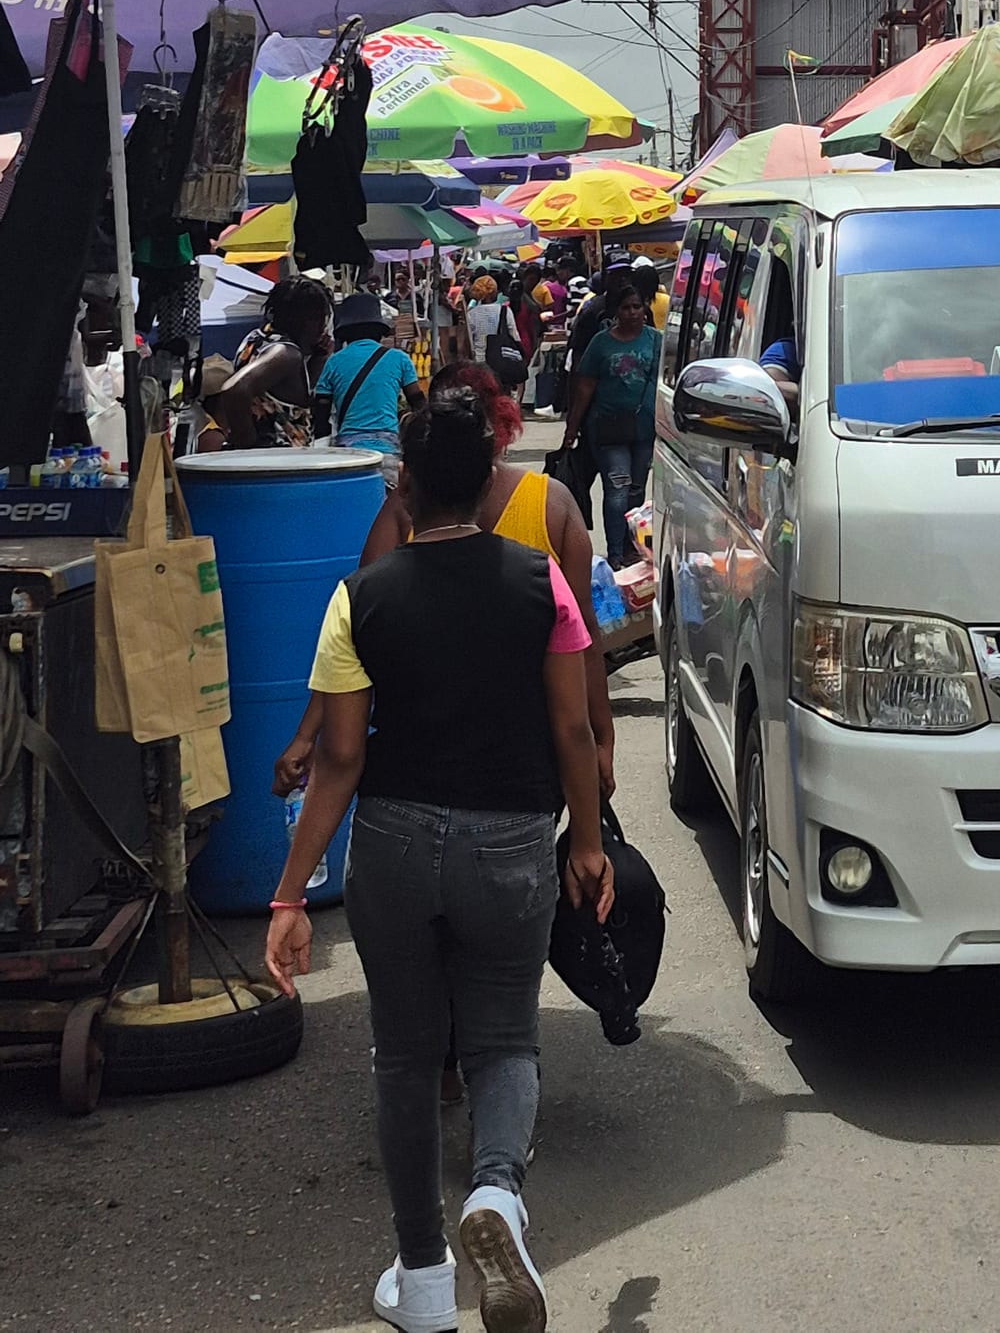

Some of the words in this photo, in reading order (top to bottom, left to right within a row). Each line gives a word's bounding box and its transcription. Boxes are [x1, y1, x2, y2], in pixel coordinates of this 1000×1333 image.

[377, 80, 412, 104] Extra
[377, 76, 431, 115] Perfumed
[0, 502, 72, 522] PEPSI
